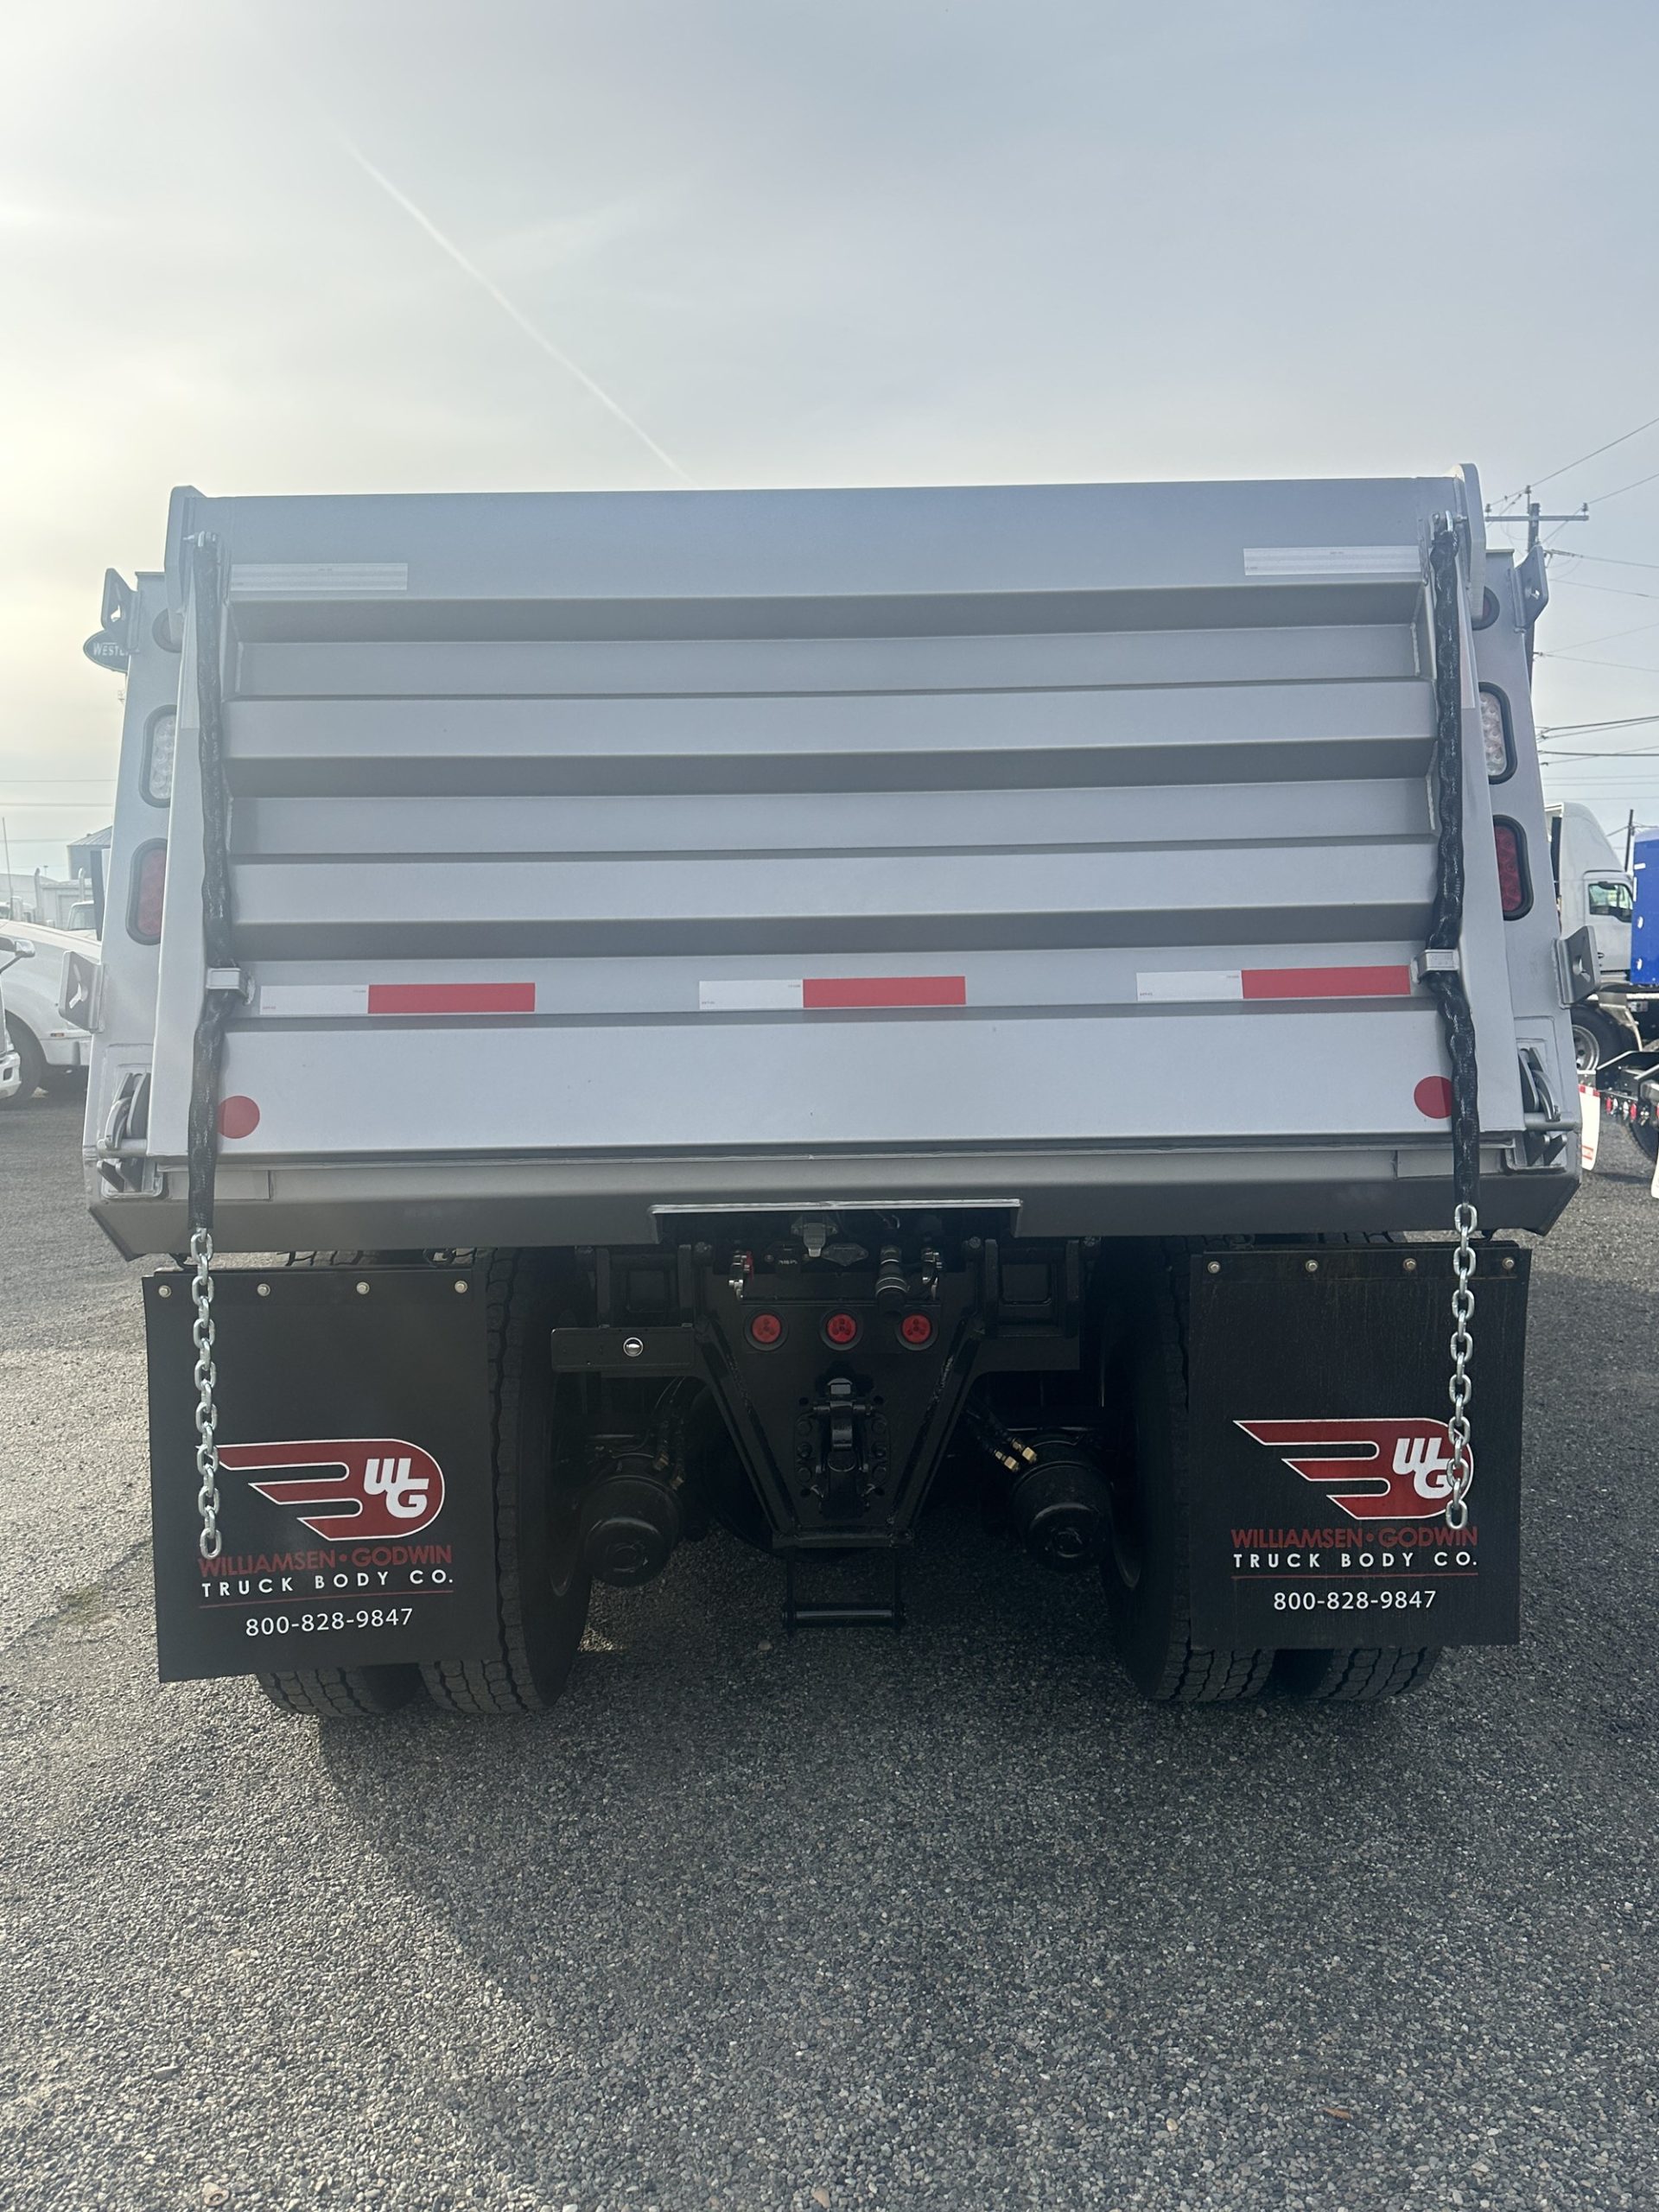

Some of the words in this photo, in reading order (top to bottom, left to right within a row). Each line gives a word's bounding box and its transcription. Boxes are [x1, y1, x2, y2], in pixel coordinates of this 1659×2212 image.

[1392, 1437, 1457, 1499] WG
[363, 1458, 429, 1518] WG
[1233, 1553, 1320, 1568] TRUCK
[1341, 1553, 1414, 1567] BODY
[1434, 1552, 1478, 1567] CO.
[202, 1577, 293, 1597] TRUCK
[315, 1571, 388, 1589] BODY
[410, 1569, 453, 1584] CO.
[1274, 1590, 1436, 1611] 800-828-9847
[245, 1608, 413, 1637] 800-828-9847
